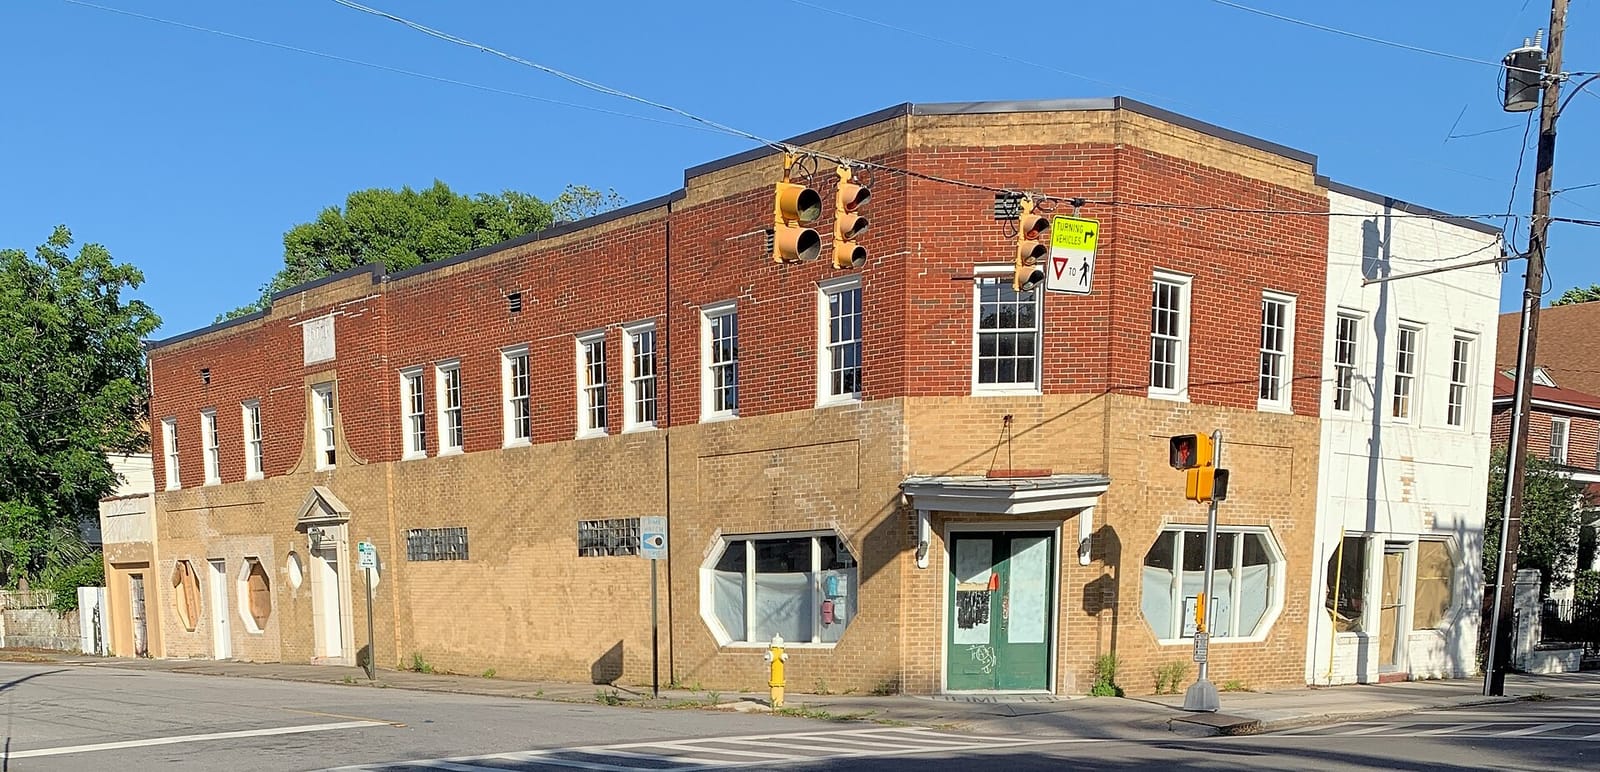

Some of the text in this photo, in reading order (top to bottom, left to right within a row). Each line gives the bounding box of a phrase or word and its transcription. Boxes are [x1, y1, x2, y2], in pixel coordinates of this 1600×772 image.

[1056, 221, 1084, 233] TURNING
[1056, 234, 1082, 245] VEHICLES
[1068, 267, 1077, 277] TO
